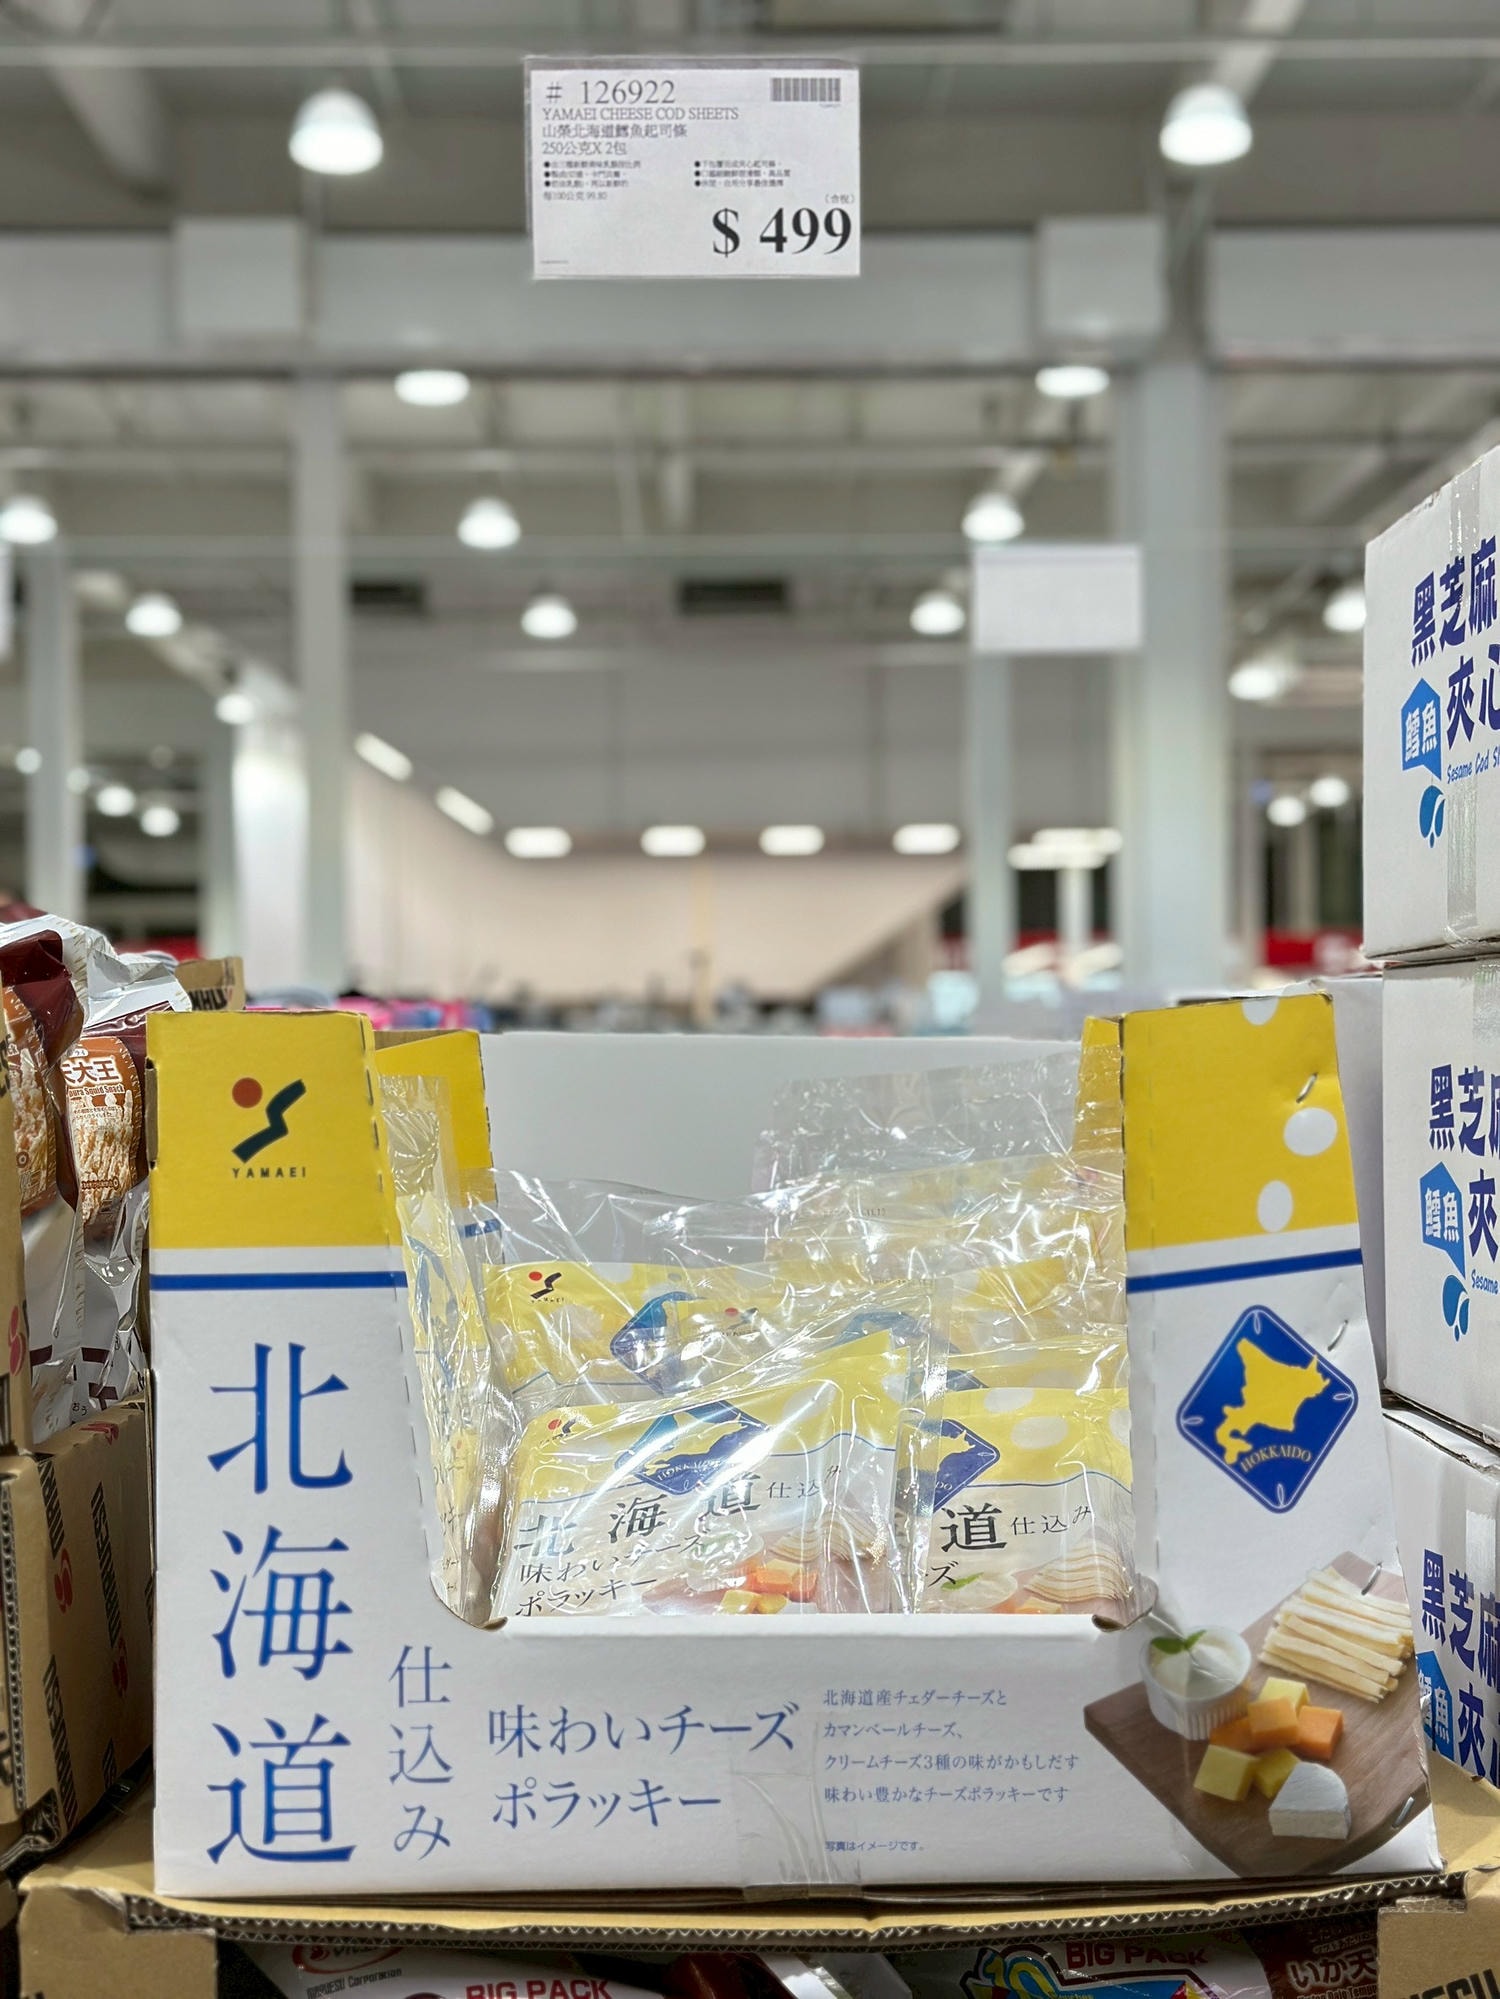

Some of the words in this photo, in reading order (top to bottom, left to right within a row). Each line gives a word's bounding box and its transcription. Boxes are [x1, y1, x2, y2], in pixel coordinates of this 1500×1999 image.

[546, 82, 562, 102] #
[581, 80, 676, 104] 126922
[542, 108, 597, 120] YAMAEI
[600, 108, 652, 120] CHEESE
[656, 108, 685, 120] COD
[688, 108, 739, 120] SHEETS
[712, 207, 740, 258] $
[760, 207, 851, 255] 499
[1411, 535, 1498, 668] 黑芝麻
[1404, 701, 1438, 762] 鱈魚
[232, 1167, 307, 1179] YAMAEI
[1425, 1187, 1460, 1243] 鱈魚
[1469, 1168, 1498, 1262] 夾
[1240, 1445, 1313, 1473] HOKKAIDO
[207, 1342, 356, 1864] 北海道
[823, 1689, 1008, 1707] 北海道産チェダーチーズと
[488, 1702, 799, 1758] 味わいチーズ
[823, 1721, 965, 1740] カマンベールチーズ、
[388, 1645, 454, 1861] 仕込み
[824, 1753, 1080, 1771] クリームチーズ3種の味がかもしだす
[492, 1777, 721, 1829] ポラッキー
[824, 1785, 1070, 1804] 味わい豊かなチーズポラッキーです
[825, 1841, 924, 1852] 写真はイメージです。
[1067, 1943, 1115, 1969] BIG
